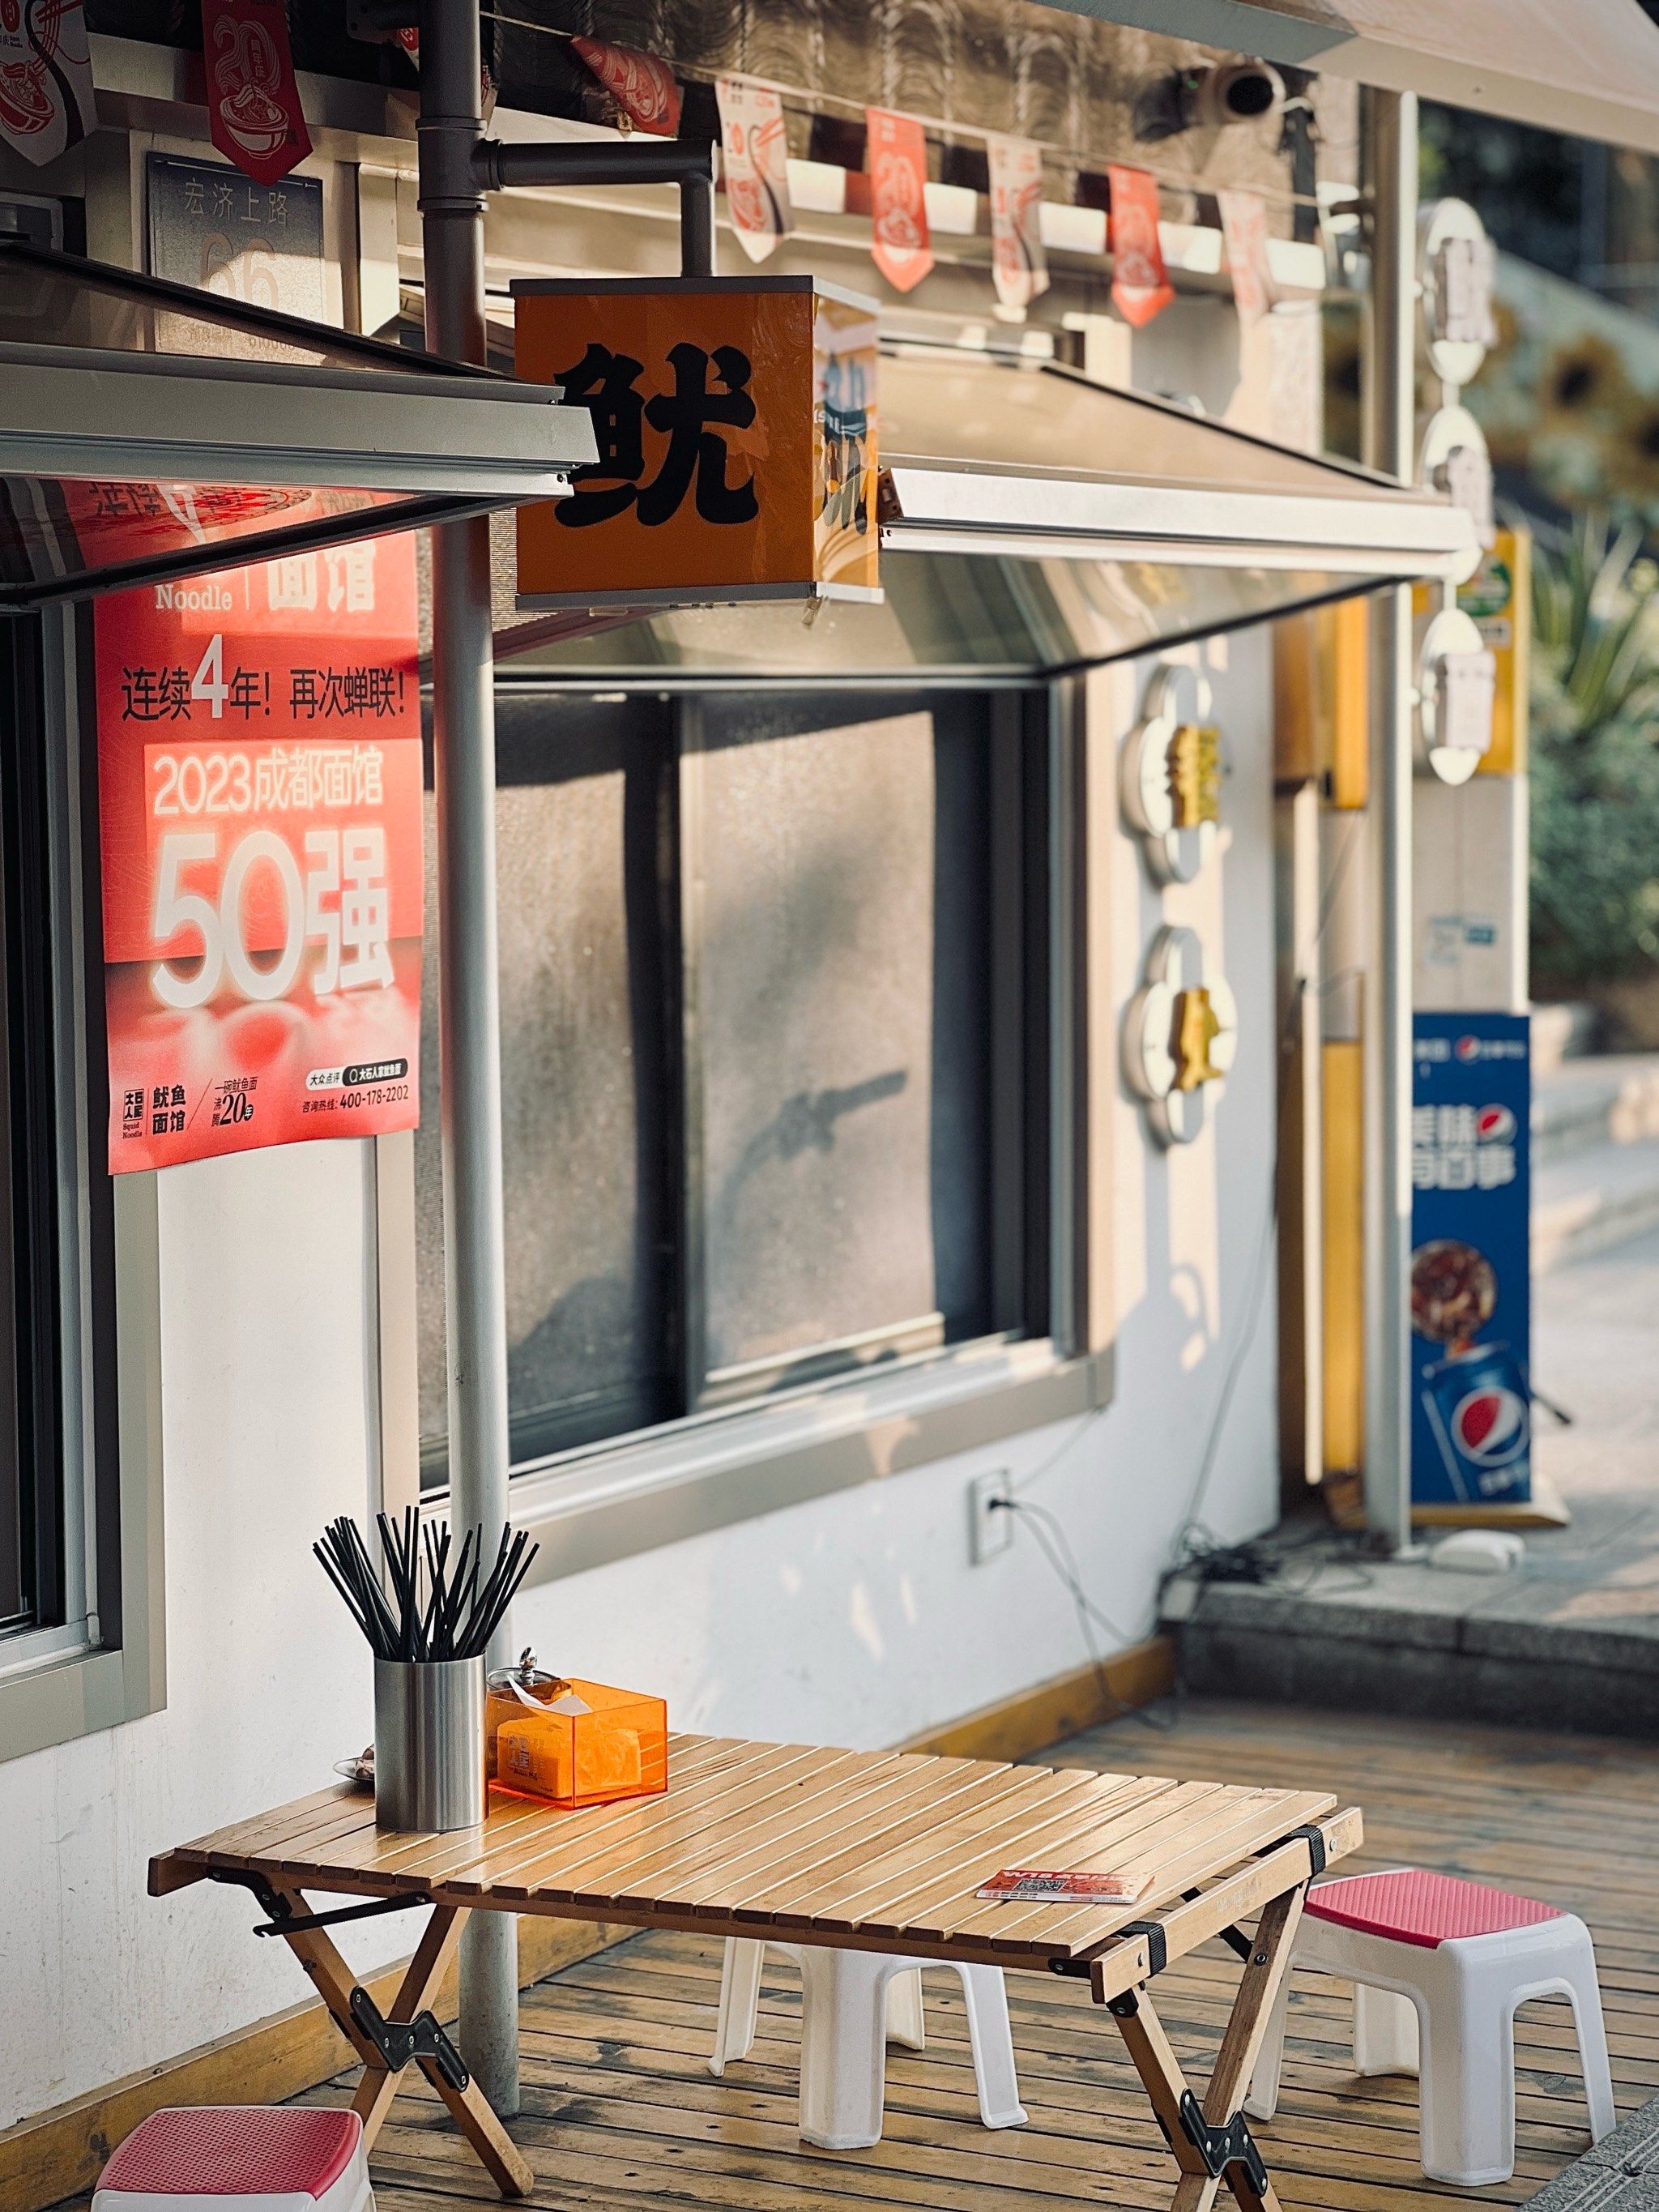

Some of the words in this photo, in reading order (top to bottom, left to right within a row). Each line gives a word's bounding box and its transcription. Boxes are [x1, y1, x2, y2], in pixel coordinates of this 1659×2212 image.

[184, 177, 289, 227] 宏济上路
[553, 342, 759, 527] 鱿
[155, 584, 233, 612] Noodle
[152, 745, 385, 816] 2023成都面馆
[152, 826, 395, 1009] 50强
[152, 1083, 186, 1109] 鱿鱼
[339, 1085, 409, 1109] 400-178-2202
[152, 1109, 186, 1135] 面馆
